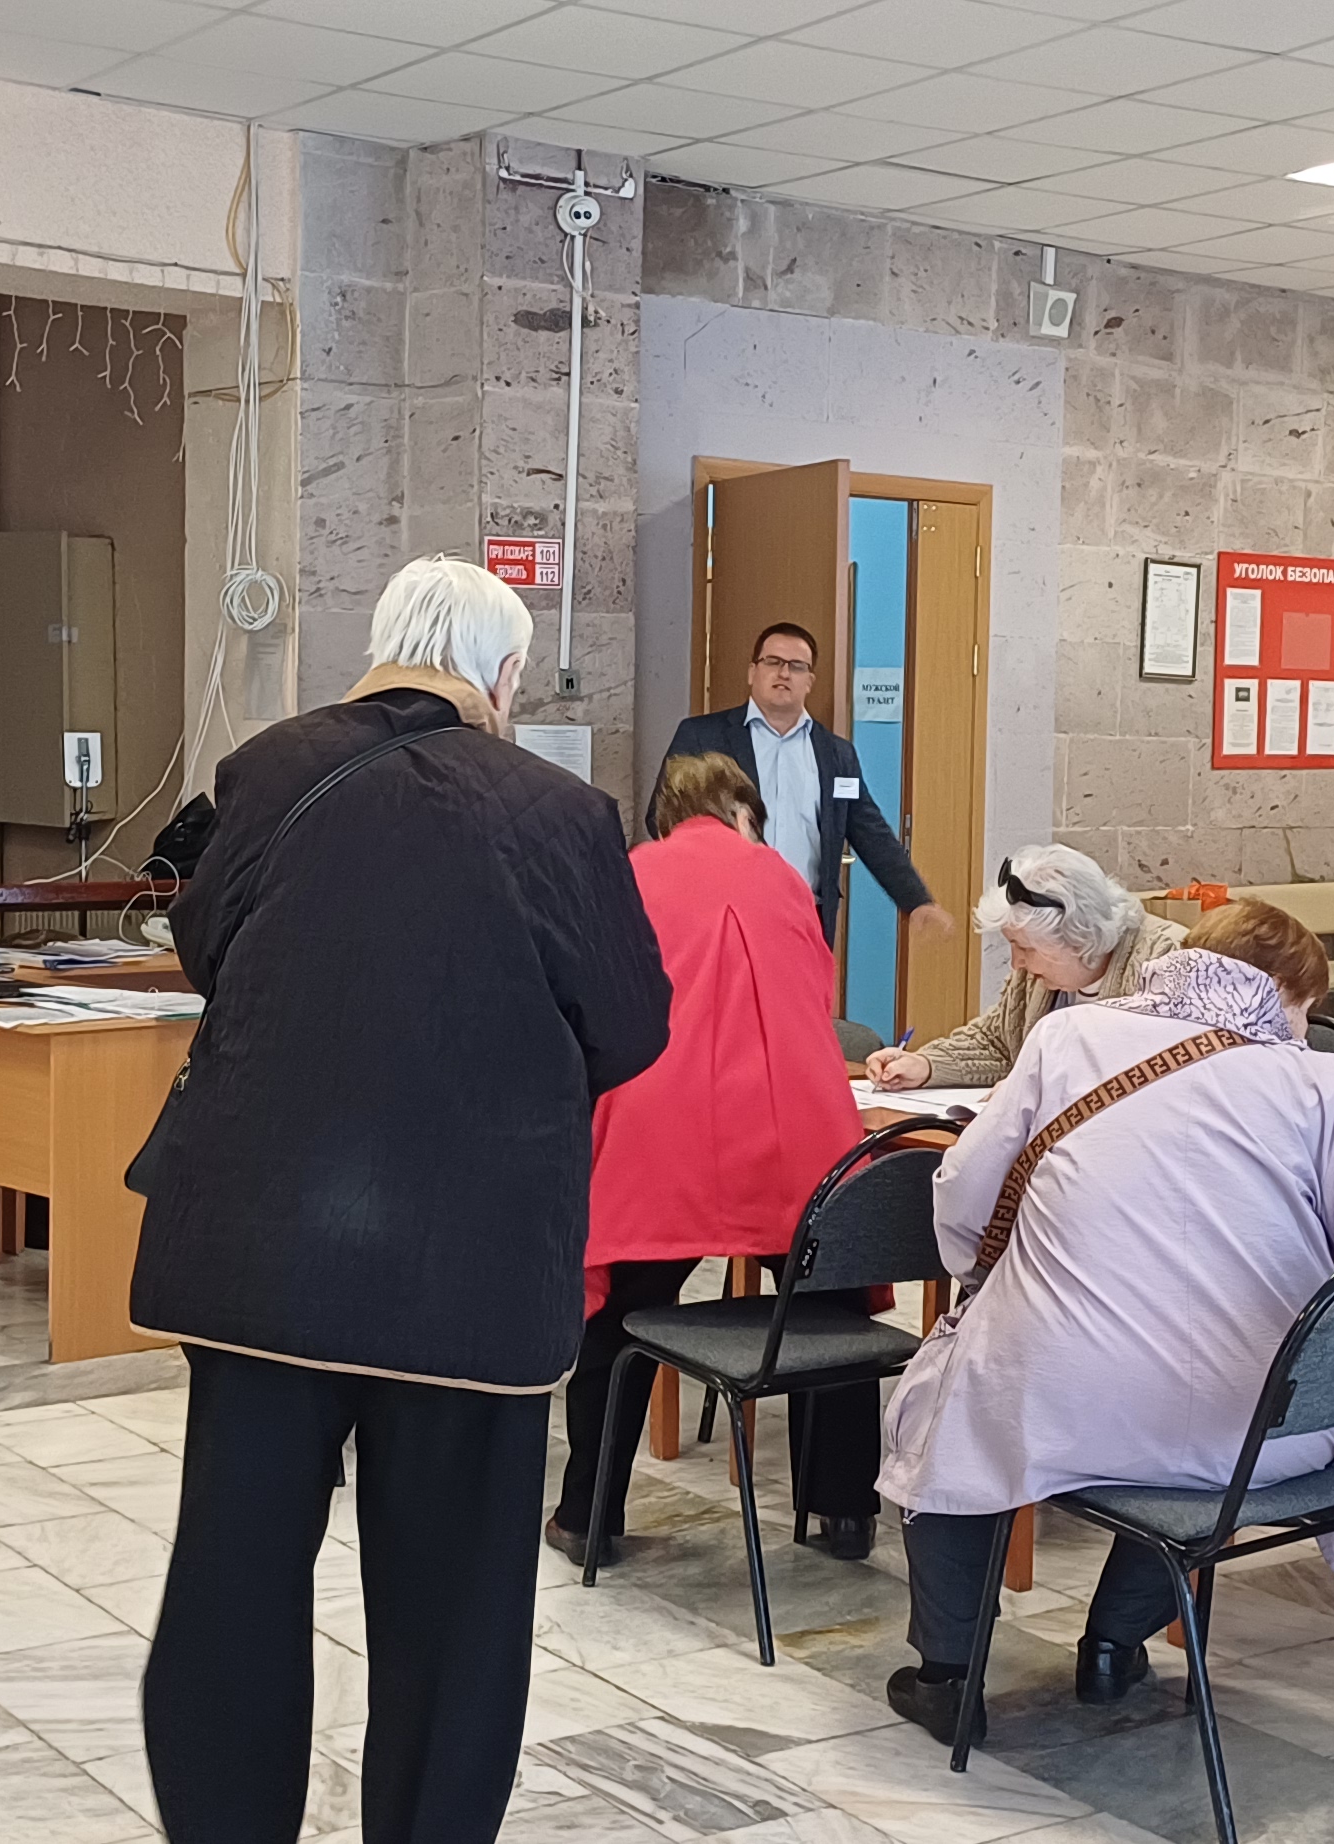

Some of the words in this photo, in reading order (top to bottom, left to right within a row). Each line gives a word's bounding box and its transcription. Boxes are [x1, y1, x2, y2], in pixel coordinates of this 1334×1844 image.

[489, 545, 503, 559] ПРИ
[504, 546, 533, 560] ПОЖАРЕ
[540, 549, 556, 561] 101
[540, 570, 556, 583] 112
[1233, 562, 1284, 581] УГОЛОК
[861, 683, 900, 692] МУЖСКОЙ
[866, 696, 895, 705] ТУАЛЕТ
